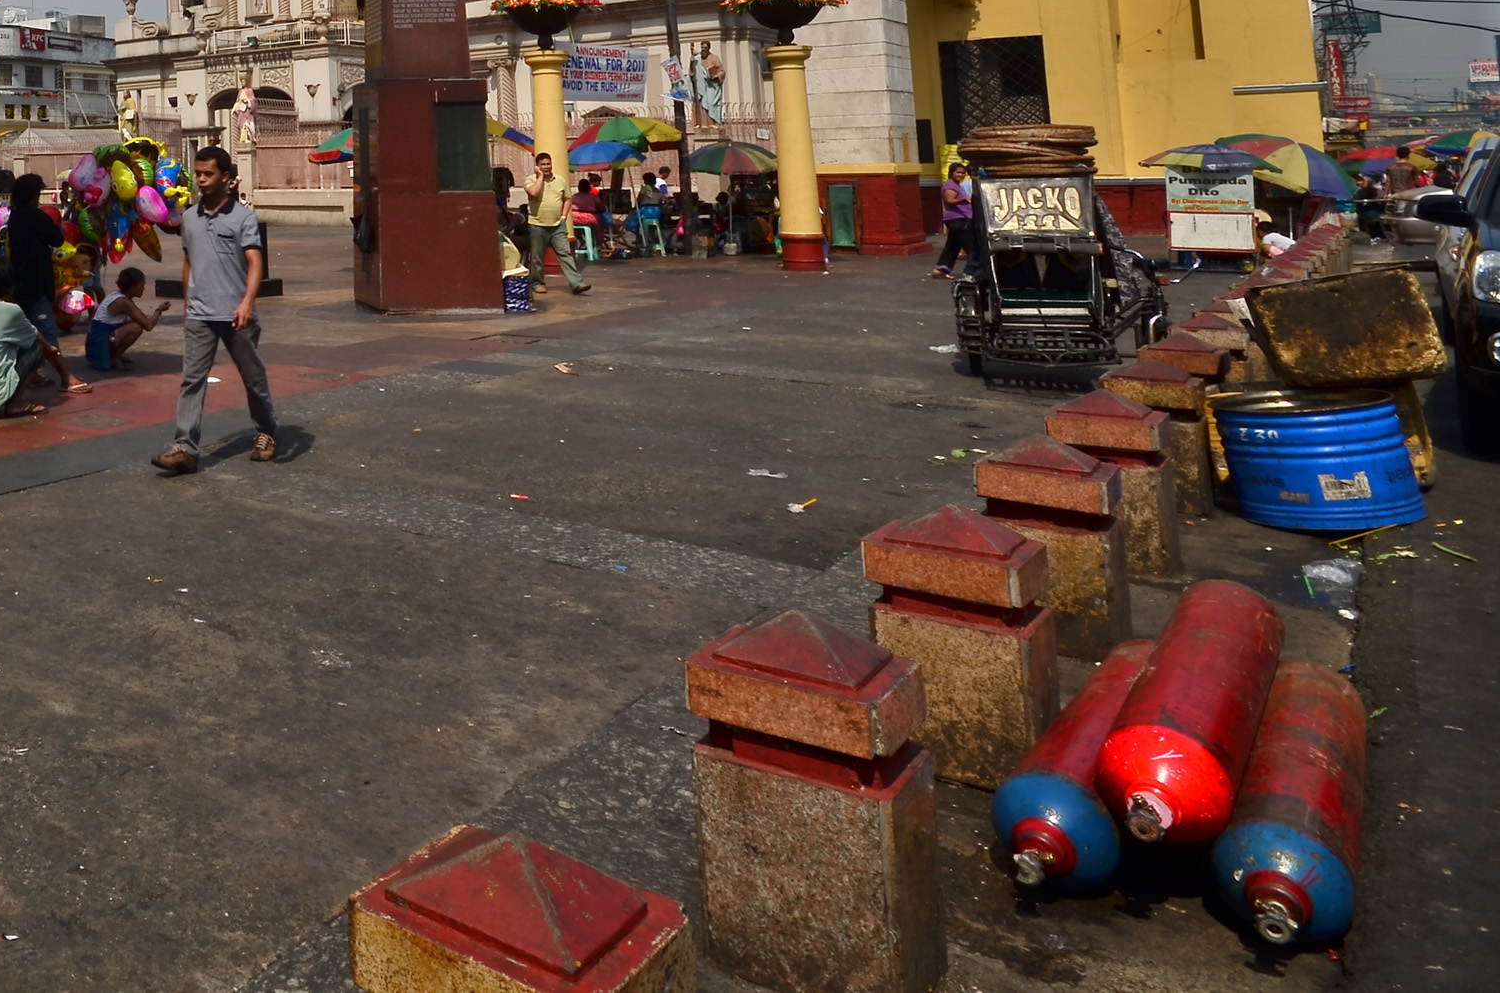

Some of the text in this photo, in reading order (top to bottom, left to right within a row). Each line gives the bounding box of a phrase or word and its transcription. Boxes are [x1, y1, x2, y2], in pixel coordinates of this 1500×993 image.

[31, 34, 44, 42] KFC
[576, 46, 626, 58] ANNOUNCEMENT
[606, 58, 623, 71] FOR
[626, 59, 645, 72] 2011
[570, 70, 583, 80] YOUR
[584, 70, 607, 81] BUSINESS
[607, 71, 628, 82] PERMITS
[629, 72, 644, 82] EARLY
[562, 80, 583, 91] AVOID
[586, 81, 599, 92] THE
[1168, 176, 1247, 185] Pumarada
[1188, 187, 1219, 196] Dito
[993, 186, 1082, 221] JACKO
